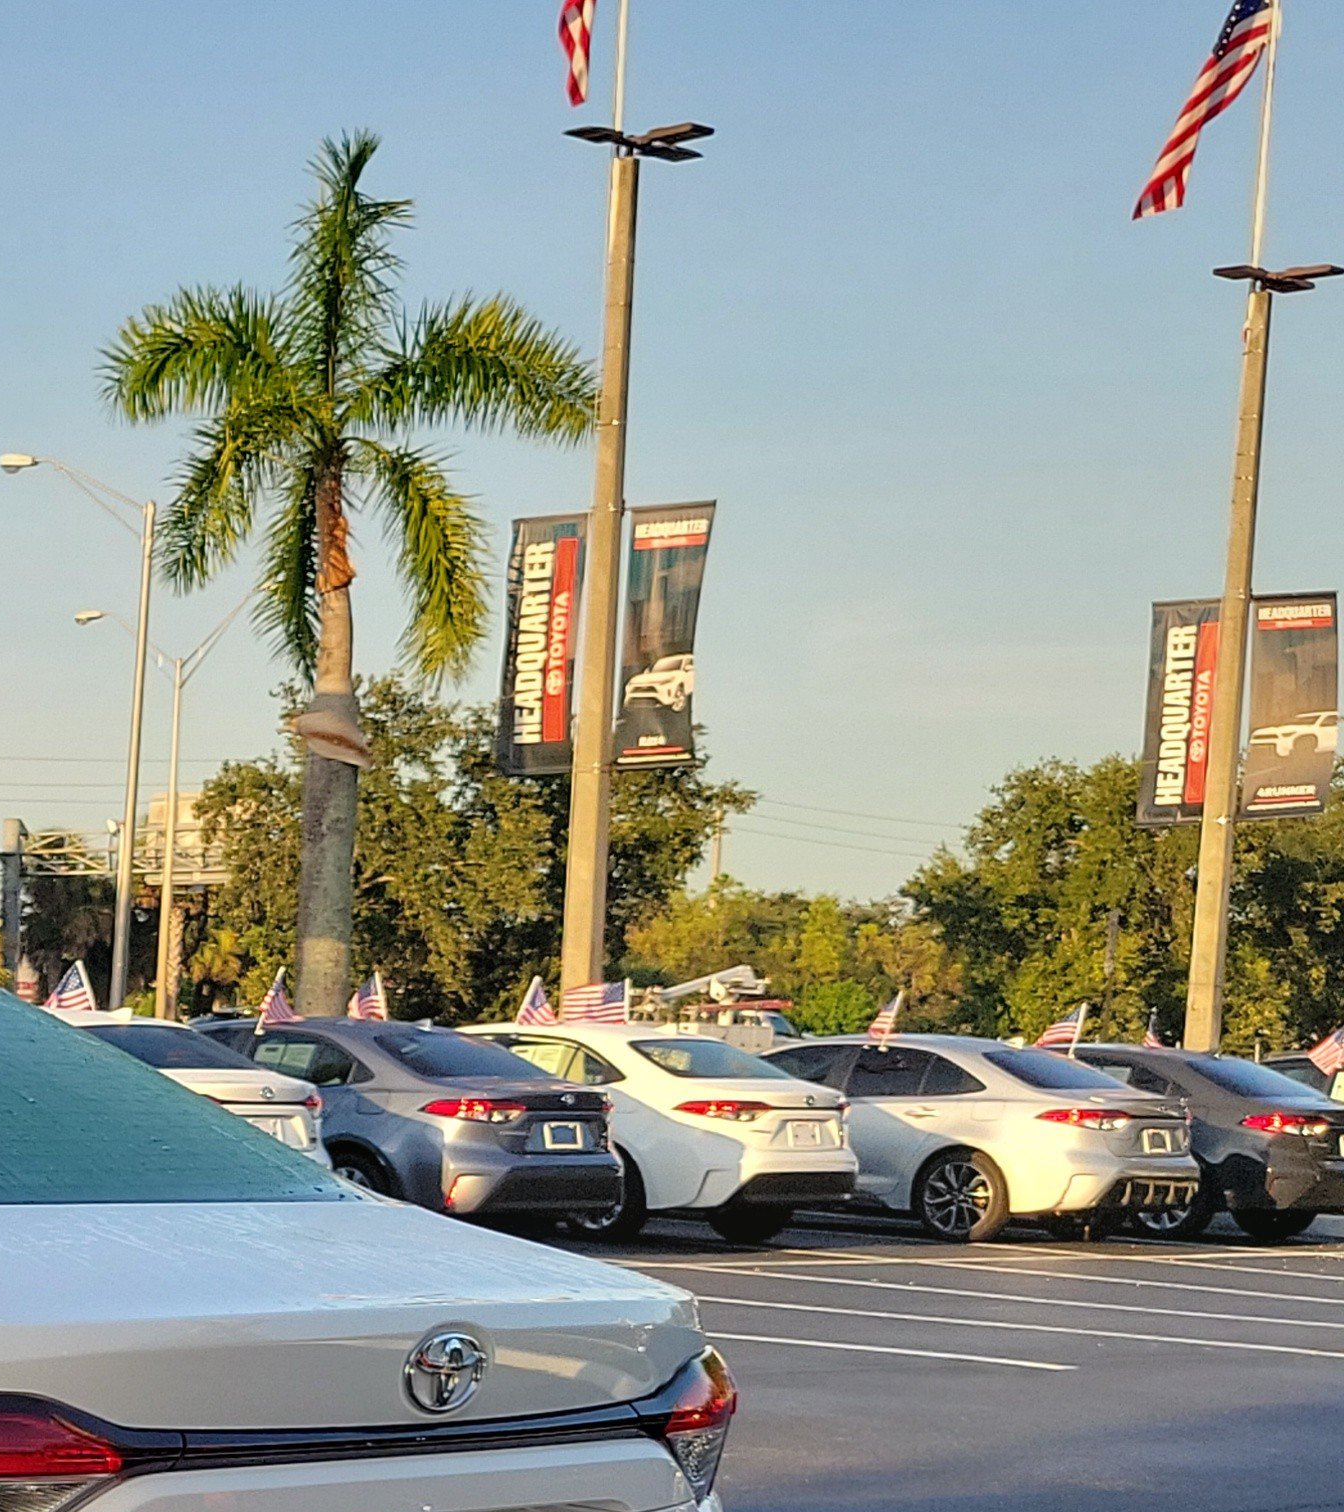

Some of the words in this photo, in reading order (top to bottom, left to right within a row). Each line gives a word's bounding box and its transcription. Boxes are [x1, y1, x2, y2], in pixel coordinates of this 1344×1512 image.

[513, 540, 556, 744] HEADQUARTER
[549, 591, 571, 675] TOYOTA
[1154, 624, 1197, 805] HEADQUARTER
[1193, 670, 1211, 741] TOYOTA
